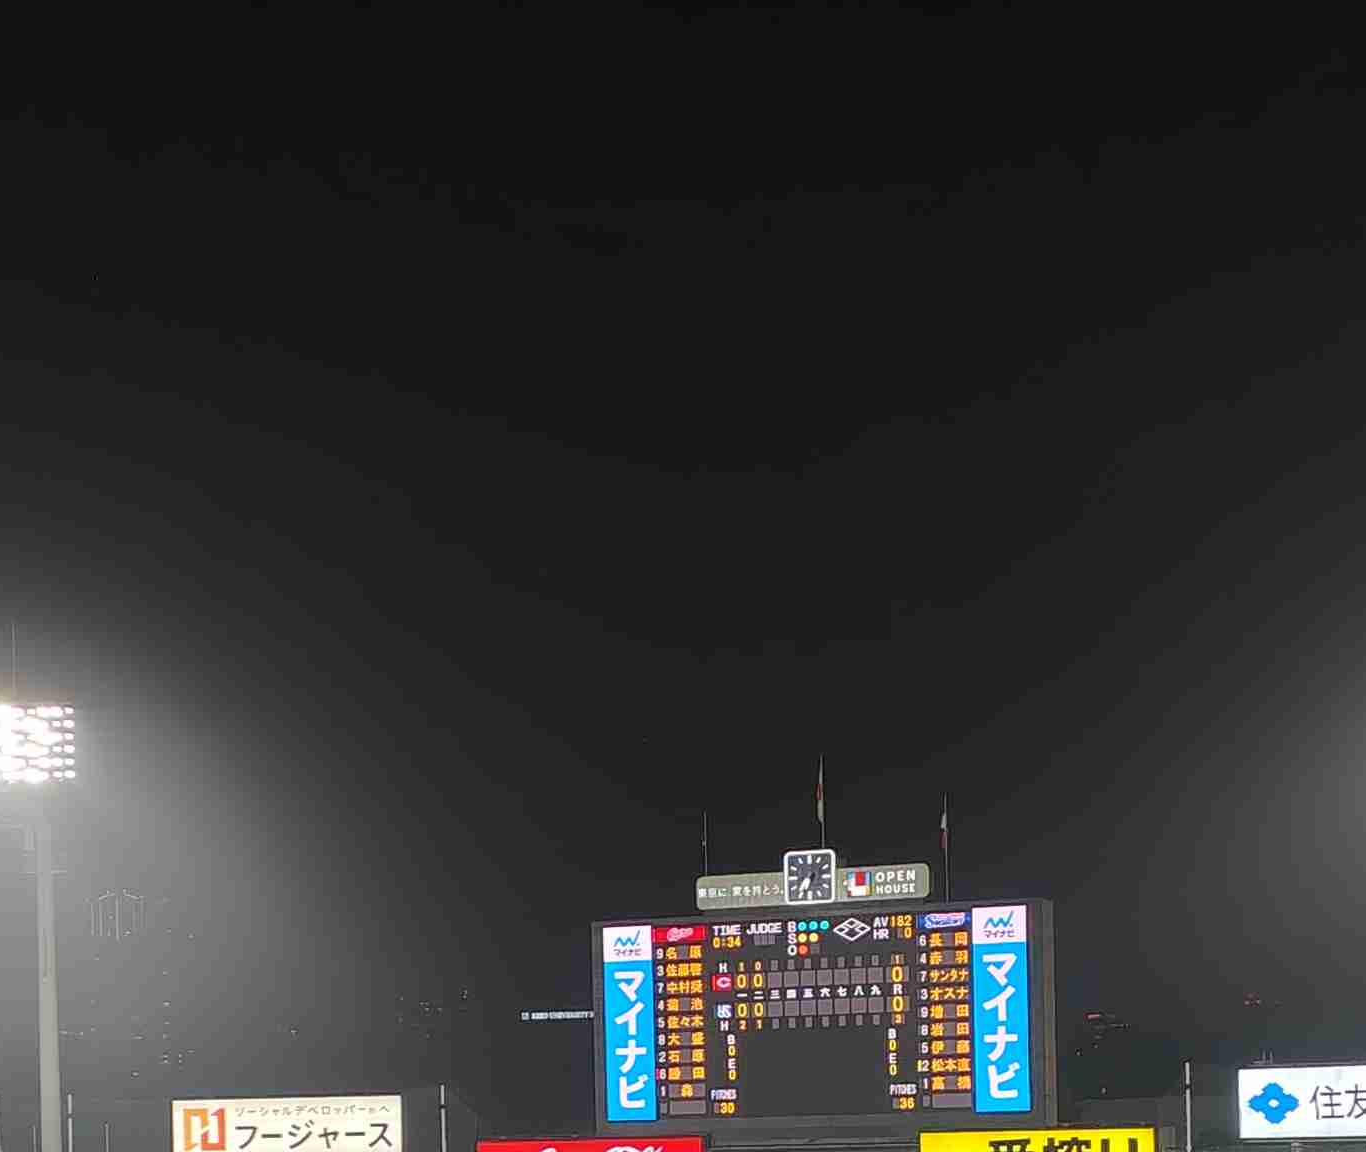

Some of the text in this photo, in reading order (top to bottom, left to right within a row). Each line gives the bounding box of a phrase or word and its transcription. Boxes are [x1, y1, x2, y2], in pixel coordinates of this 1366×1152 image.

[875, 870, 916, 882] OPEN
[875, 883, 916, 894] HOUSE
[890, 915, 912, 927] 182
[713, 925, 741, 935] TIME
[747, 922, 782, 934] JUDGE
[984, 930, 1015, 938] マイナビ
[873, 929, 889, 940] HR
[713, 936, 741, 948] 0:34
[737, 974, 747, 988] 0
[753, 973, 764, 988] 0
[930, 969, 969, 983] サンタナ
[930, 988, 969, 1000] オスナ
[737, 1003, 748, 1017] 0
[753, 1002, 764, 1016] 0
[982, 953, 1020, 1098] マイナビ
[614, 971, 648, 1108] マイナビ
[235, 1120, 393, 1149] フージャース
